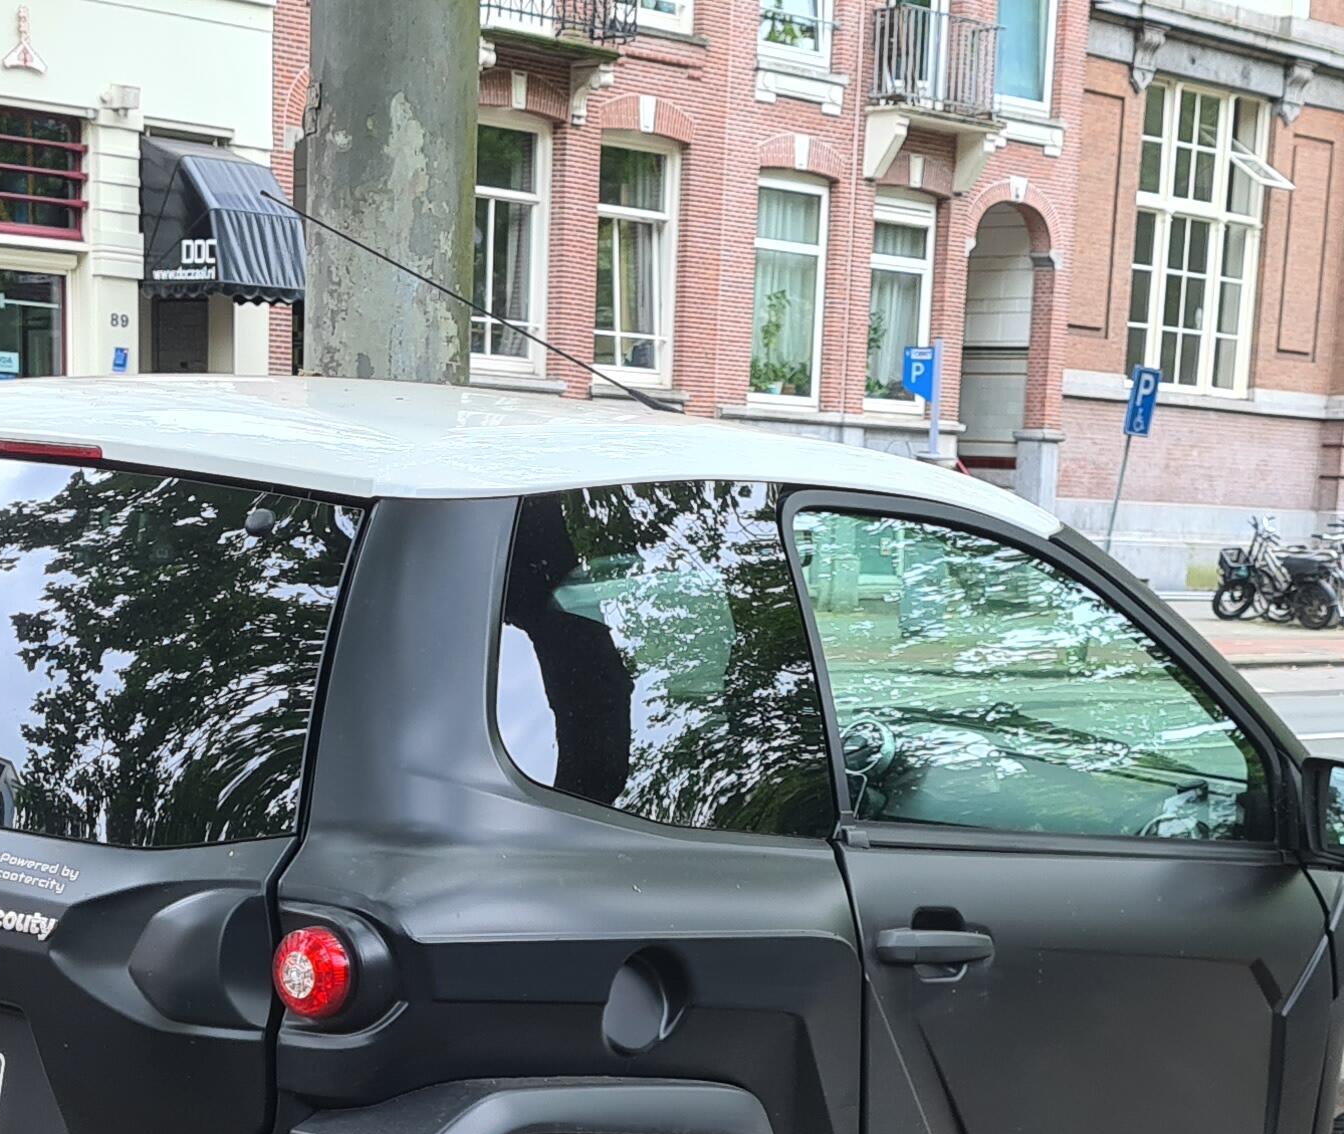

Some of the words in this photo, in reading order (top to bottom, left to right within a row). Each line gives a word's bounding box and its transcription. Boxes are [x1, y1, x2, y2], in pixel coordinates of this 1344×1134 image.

[181, 238, 217, 264] DOC
[111, 313, 129, 328] 89
[911, 361, 925, 384] P
[1136, 373, 1155, 407] P
[61, 865, 80, 881] by
